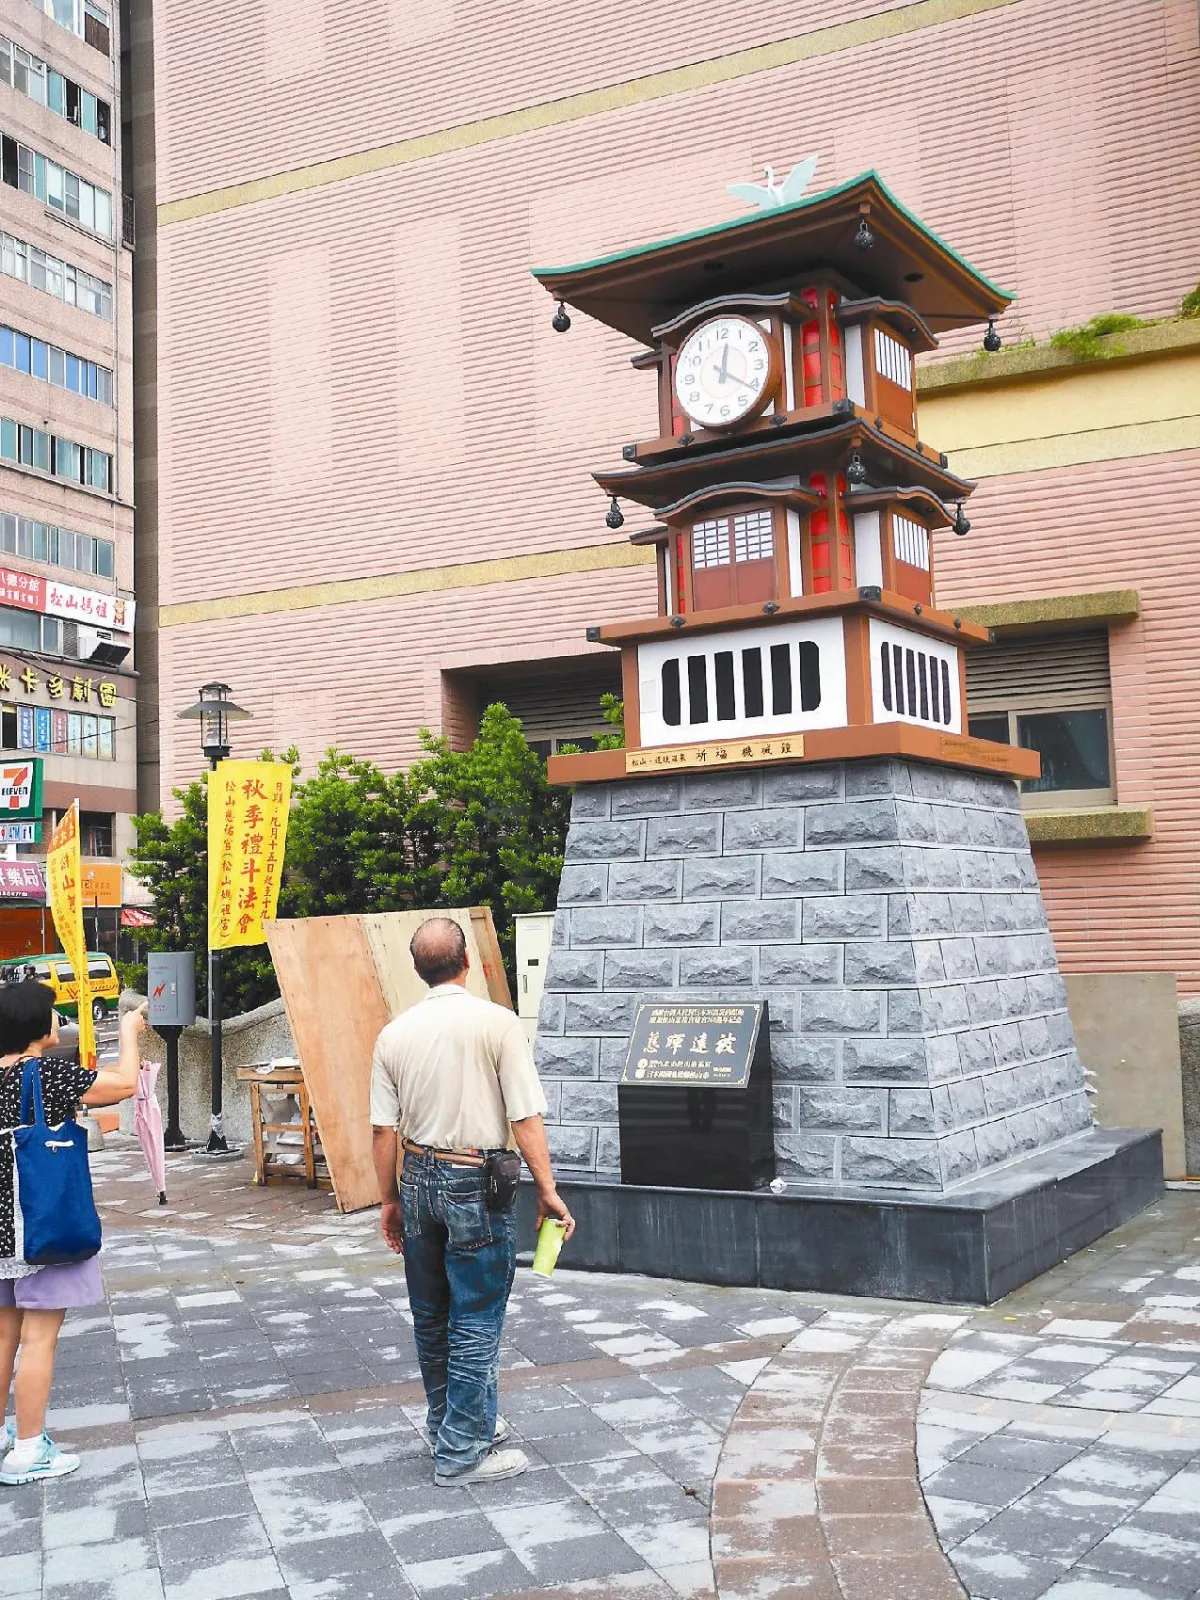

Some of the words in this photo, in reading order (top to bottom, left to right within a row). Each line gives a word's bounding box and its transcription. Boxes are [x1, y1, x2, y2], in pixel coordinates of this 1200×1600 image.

[716, 328, 729, 341] 12
[738, 330, 742, 340] 1
[697, 340, 710, 352] 11
[748, 341, 759, 353] 2
[688, 355, 702, 368] 10
[753, 360, 764, 371] 3
[684, 374, 696, 385] 9
[689, 391, 700, 402] 8
[737, 395, 748, 407] 5
[704, 403, 714, 414] 7
[719, 405, 731, 417] 6
[237, 778, 268, 935] 秋季禮斗法會
